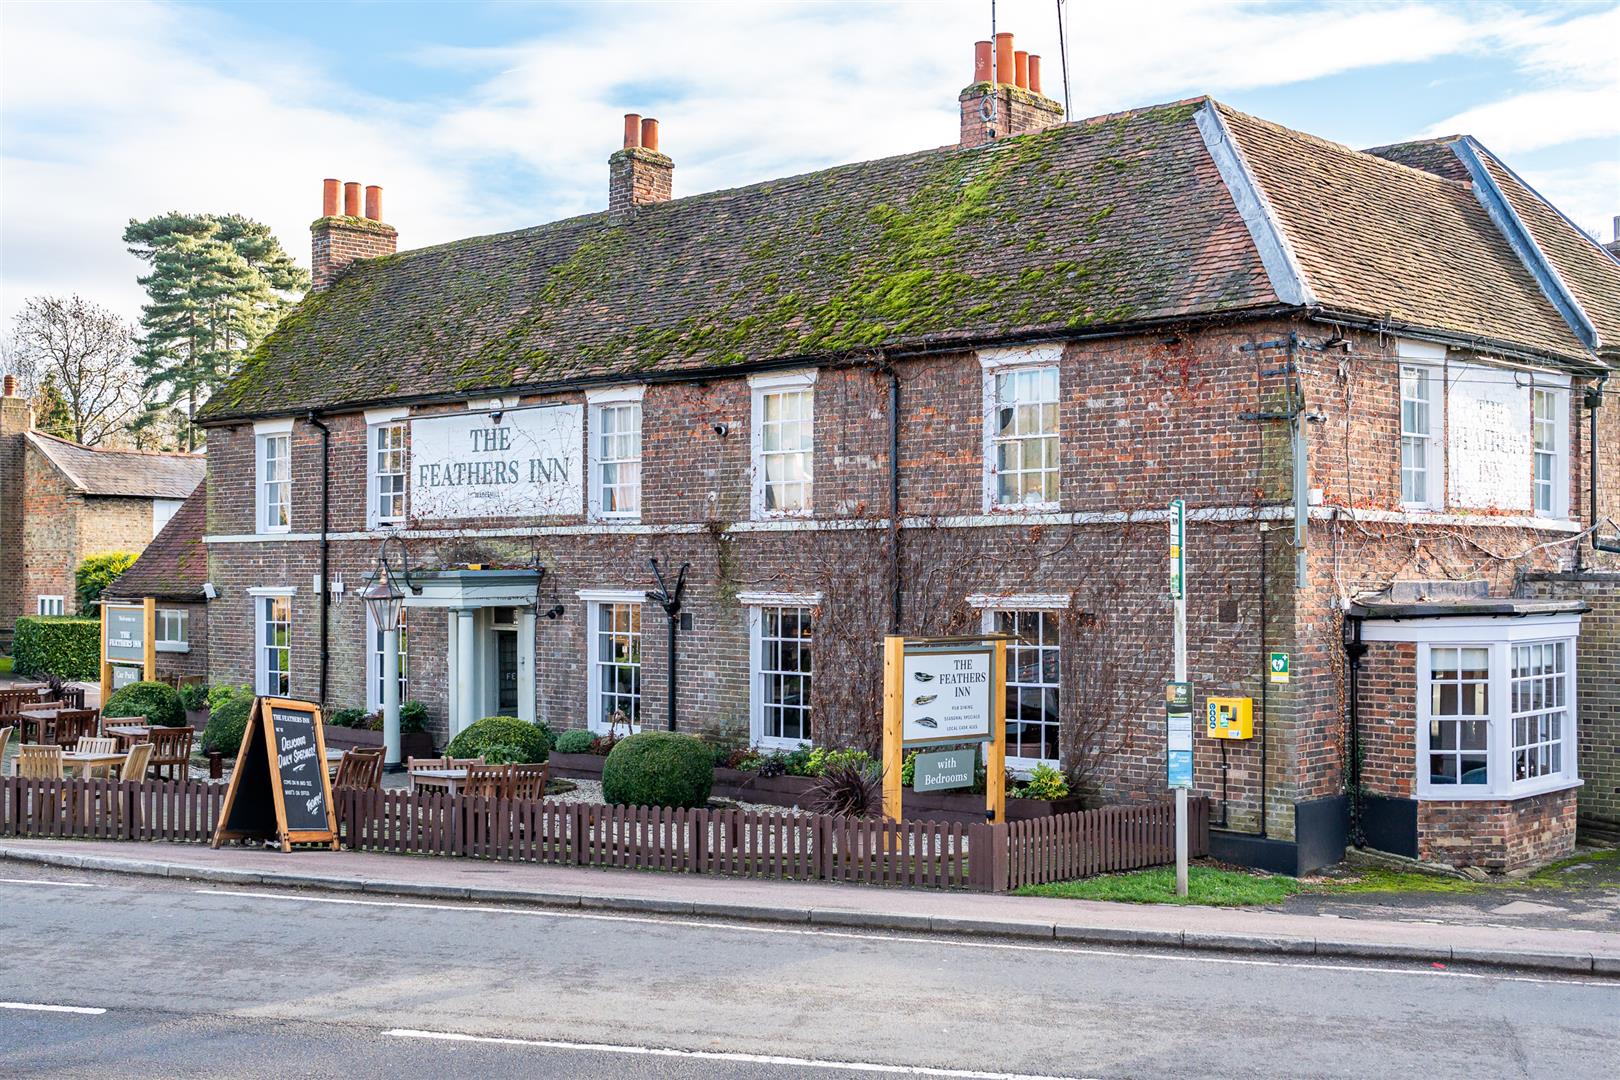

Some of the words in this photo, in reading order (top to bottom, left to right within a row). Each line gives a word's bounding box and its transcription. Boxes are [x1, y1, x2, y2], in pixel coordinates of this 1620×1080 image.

[470, 427, 511, 452] THE
[418, 460, 519, 487] FEATHERS
[528, 457, 569, 483] INN
[120, 631, 131, 639] THE
[109, 639, 133, 648] FEATHERS
[133, 640, 142, 648] INN
[953, 659, 973, 670] THE
[939, 672, 987, 685] FEATHERS
[954, 686, 971, 698] INN
[937, 757, 957, 769] with
[924, 772, 968, 786] Bedrooms
